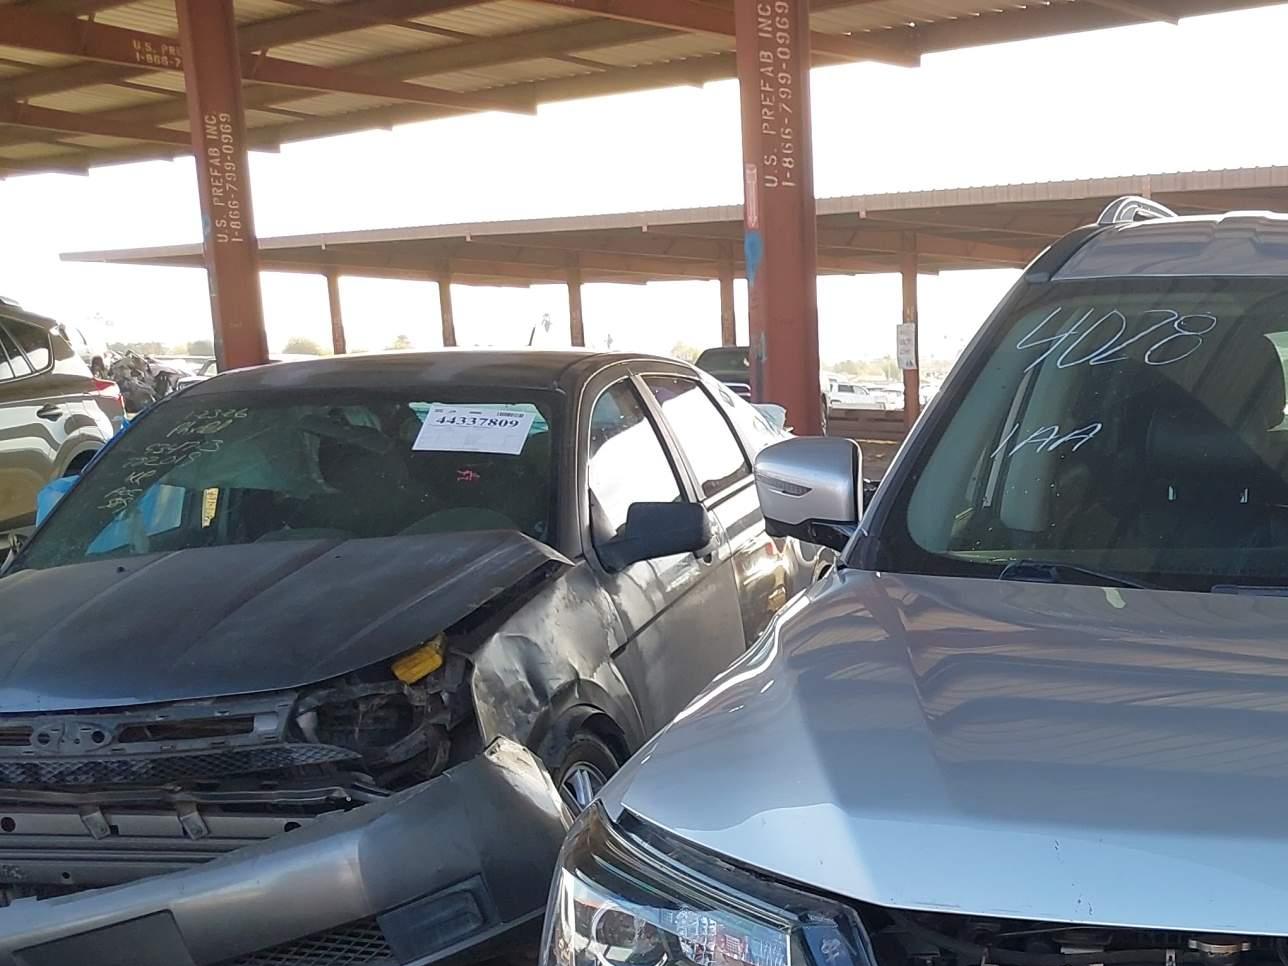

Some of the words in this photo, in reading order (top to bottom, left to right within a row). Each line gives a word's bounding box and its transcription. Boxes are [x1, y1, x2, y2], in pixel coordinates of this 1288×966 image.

[760, 50, 777, 135] PREFAB
[775, 1, 796, 187] 1-866-799-0969
[208, 147, 226, 206] PREFAB
[219, 113, 244, 243] 1-866-799-0969
[1016, 306, 1217, 373] 4028
[436, 415, 519, 427] 44337809
